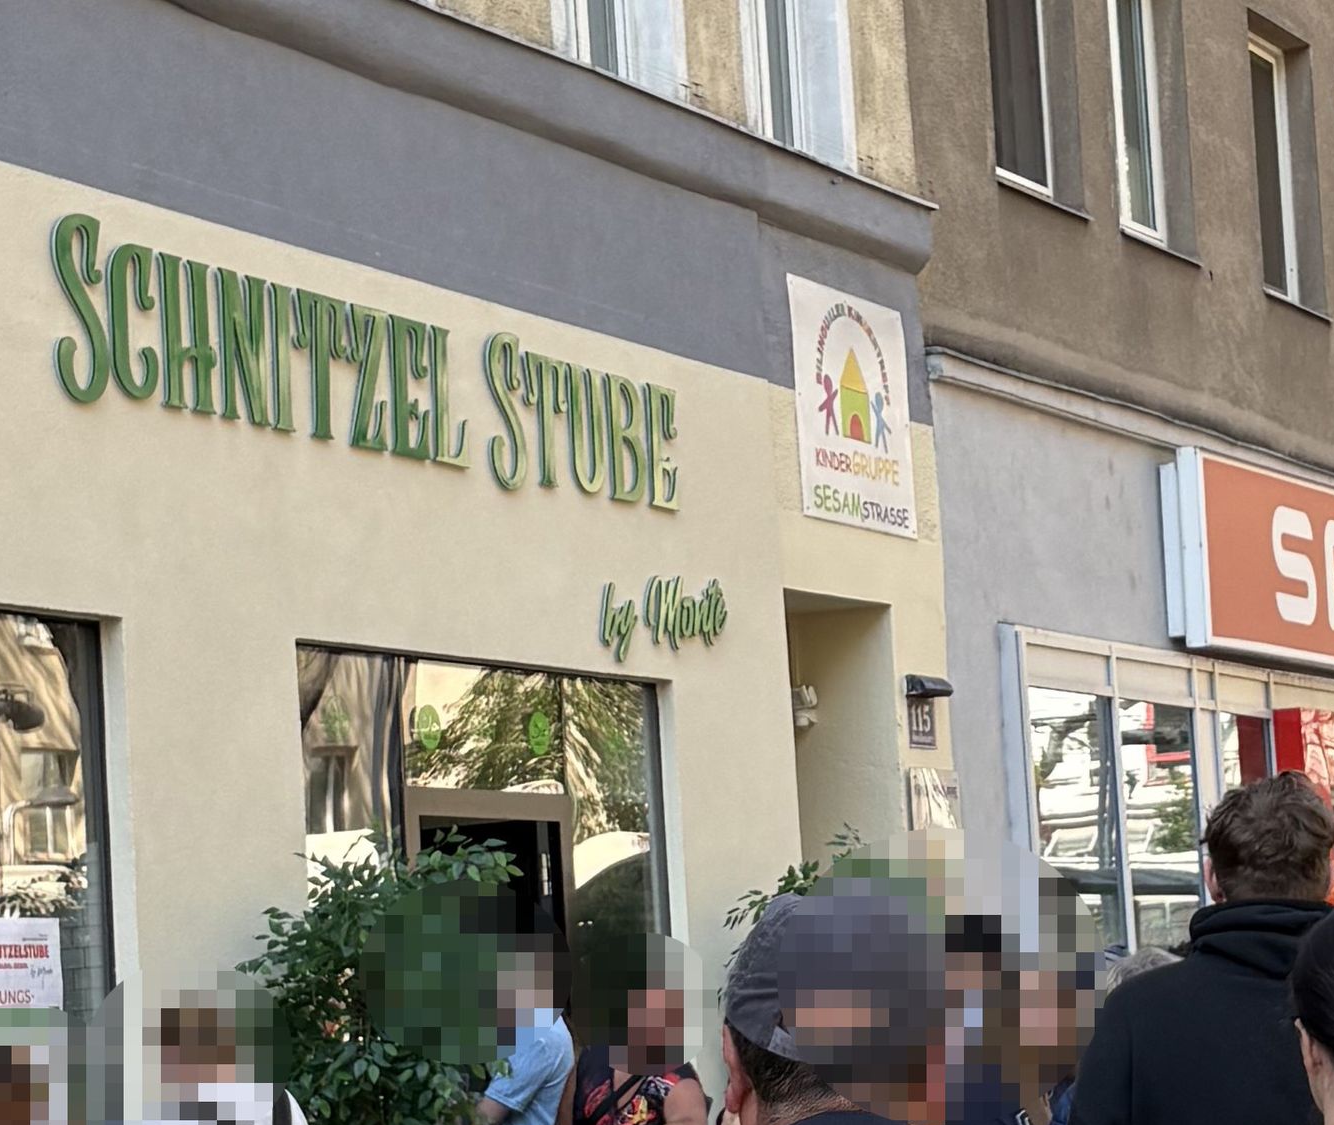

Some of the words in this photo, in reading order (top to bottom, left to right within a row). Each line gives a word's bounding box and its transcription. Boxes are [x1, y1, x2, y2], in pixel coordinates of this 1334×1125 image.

[51, 213, 469, 470] SCHNITZEL
[483, 332, 680, 512] STUBE
[813, 484, 910, 529] SESAMSTRASSE
[599, 581, 638, 663] by
[911, 704, 931, 732] 115
